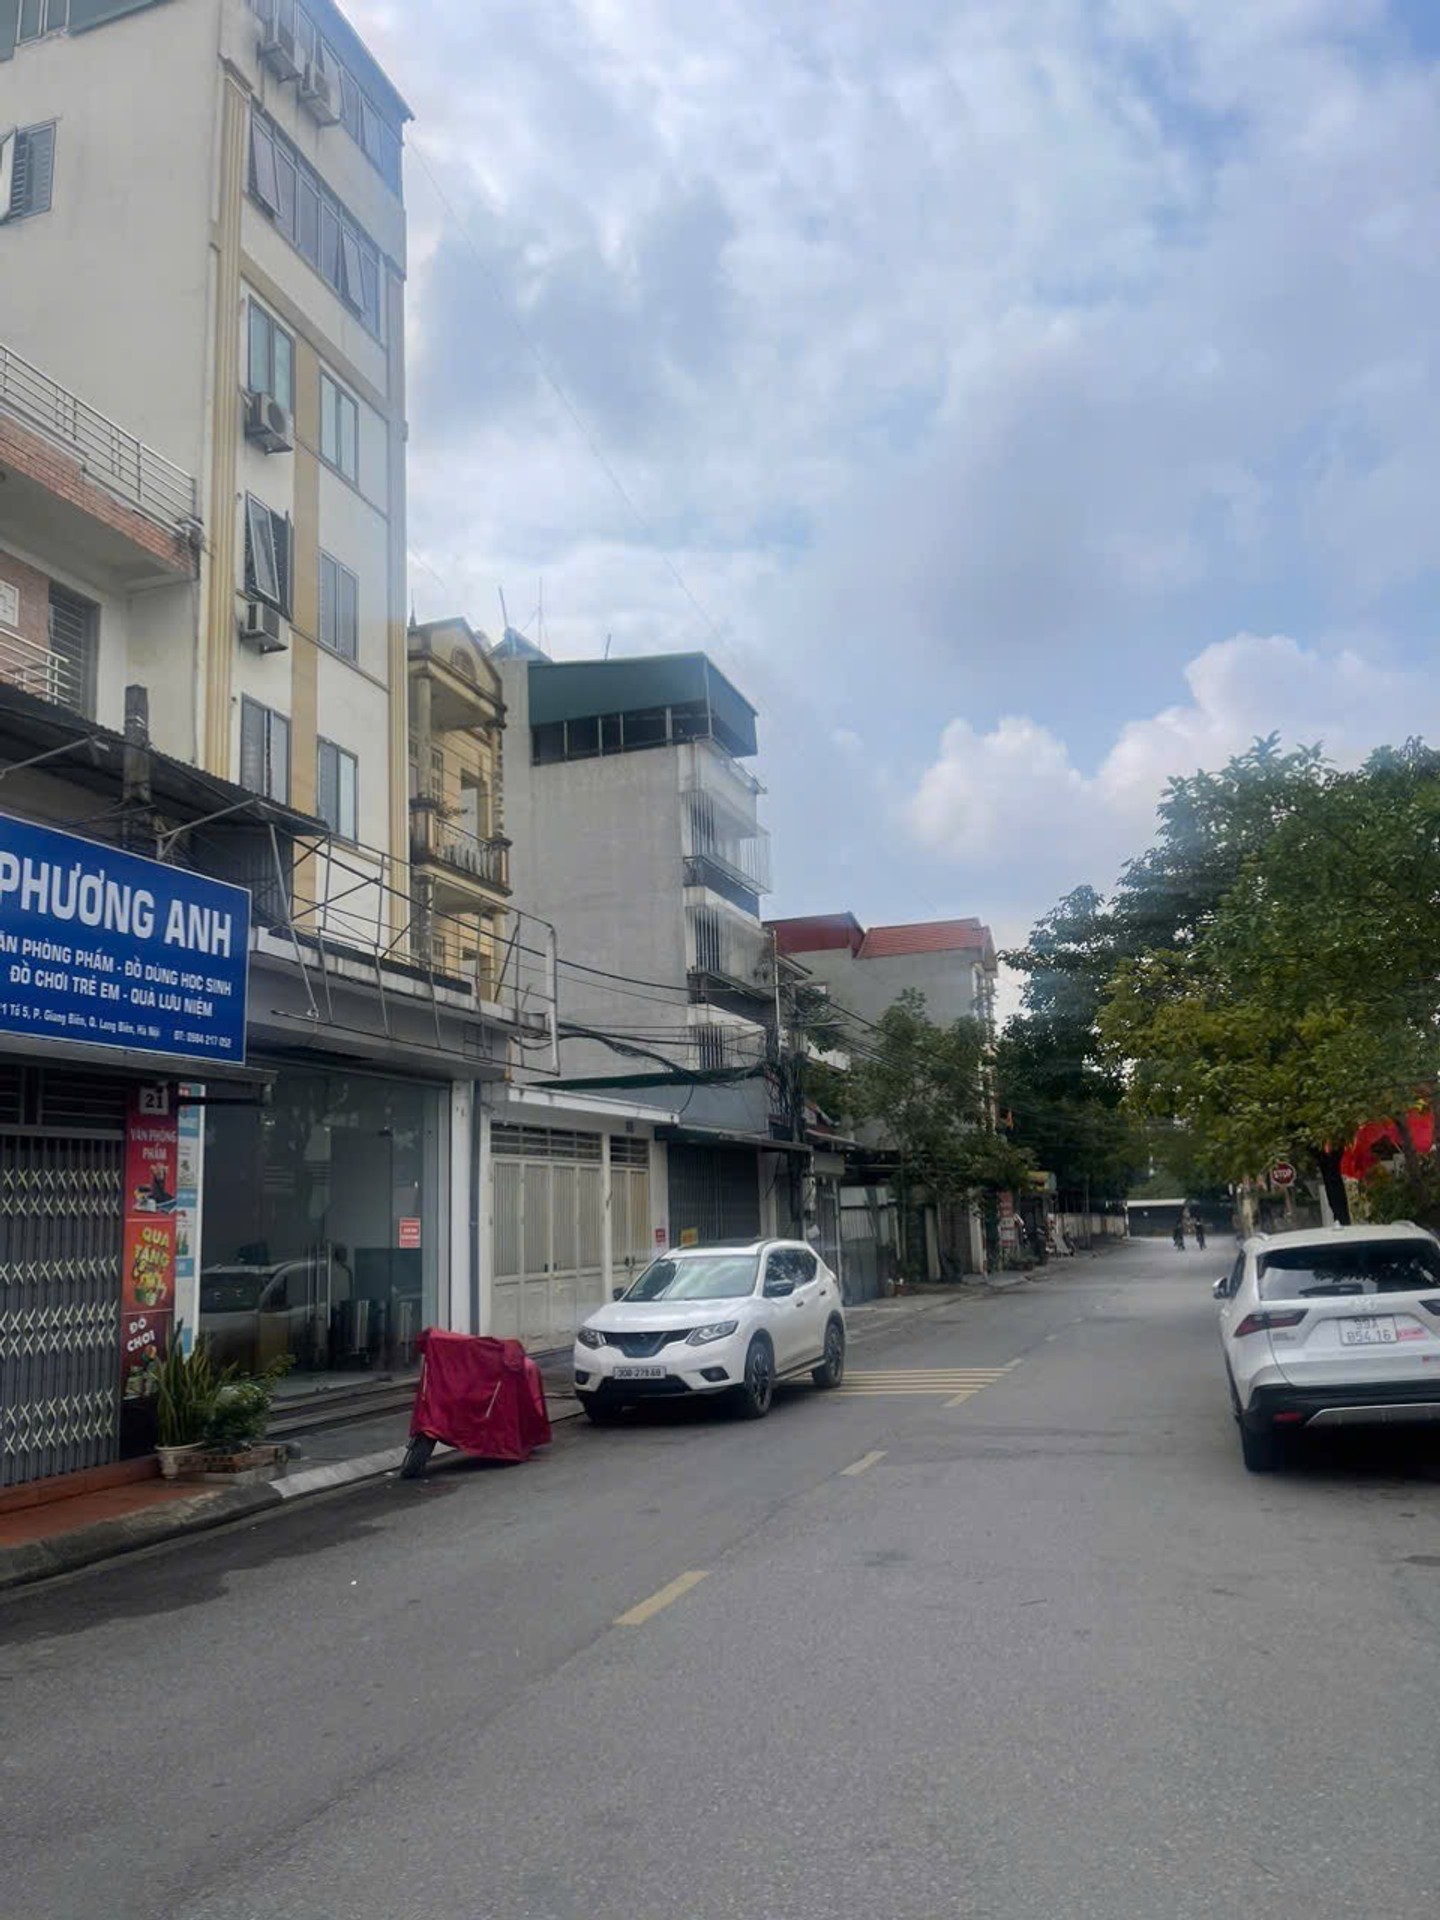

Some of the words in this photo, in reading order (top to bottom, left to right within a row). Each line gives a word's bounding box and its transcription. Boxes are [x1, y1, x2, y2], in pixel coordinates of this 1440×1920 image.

[0, 852, 155, 939] PHƯƠNG
[164, 899, 232, 958] ANH
[9, 959, 31, 985] ĐỒ
[34, 969, 68, 991] CHƠI
[72, 974, 97, 996] TRẺ
[100, 982, 120, 1000] EM
[159, 992, 181, 1011] LƯU
[183, 996, 213, 1019] NIỆM
[22, 938, 72, 964] PHÒNG
[125, 955, 142, 978] ĐỒ
[145, 962, 179, 986] DÙNG
[181, 972, 204, 993] HỌC
[206, 977, 232, 996] SINH
[22, 1005, 32, 1020] 5,
[33, 1007, 42, 1020] P.
[88, 1016, 98, 1028] Q.
[99, 1018, 116, 1033] Long
[1273, 1168, 1293, 1179] STOP
